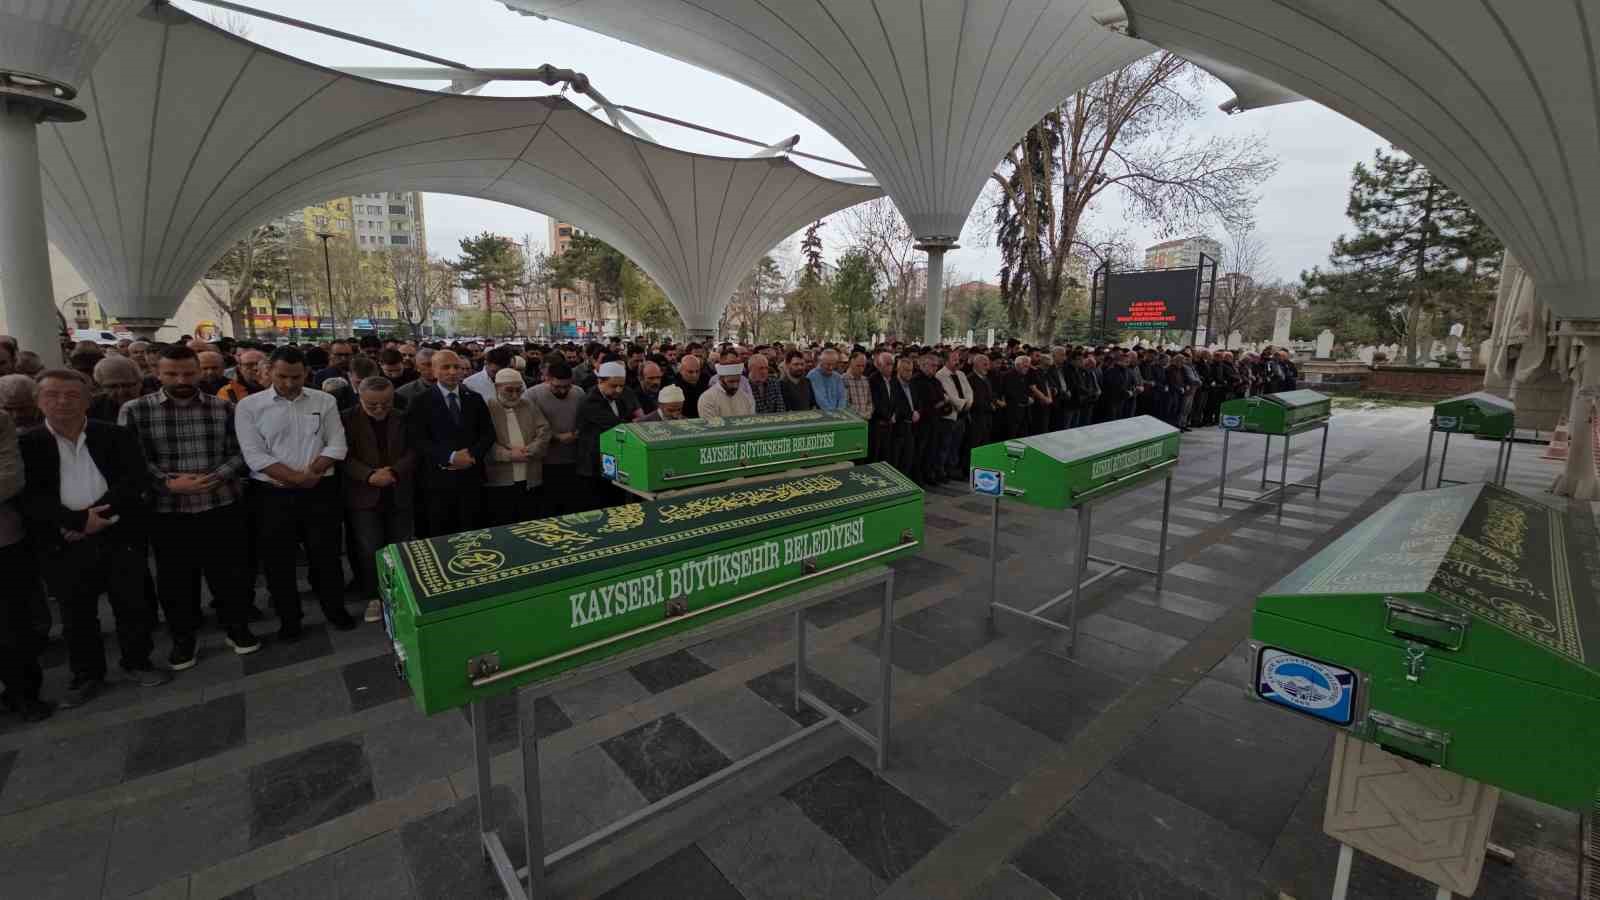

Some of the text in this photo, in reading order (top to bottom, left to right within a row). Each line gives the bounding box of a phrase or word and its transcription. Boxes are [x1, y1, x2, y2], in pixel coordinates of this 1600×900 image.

[699, 442, 738, 465] KAYSERİ
[569, 517, 865, 629] KAYSERİ BÜYÜKŞEHİR BELEDİYESİ
